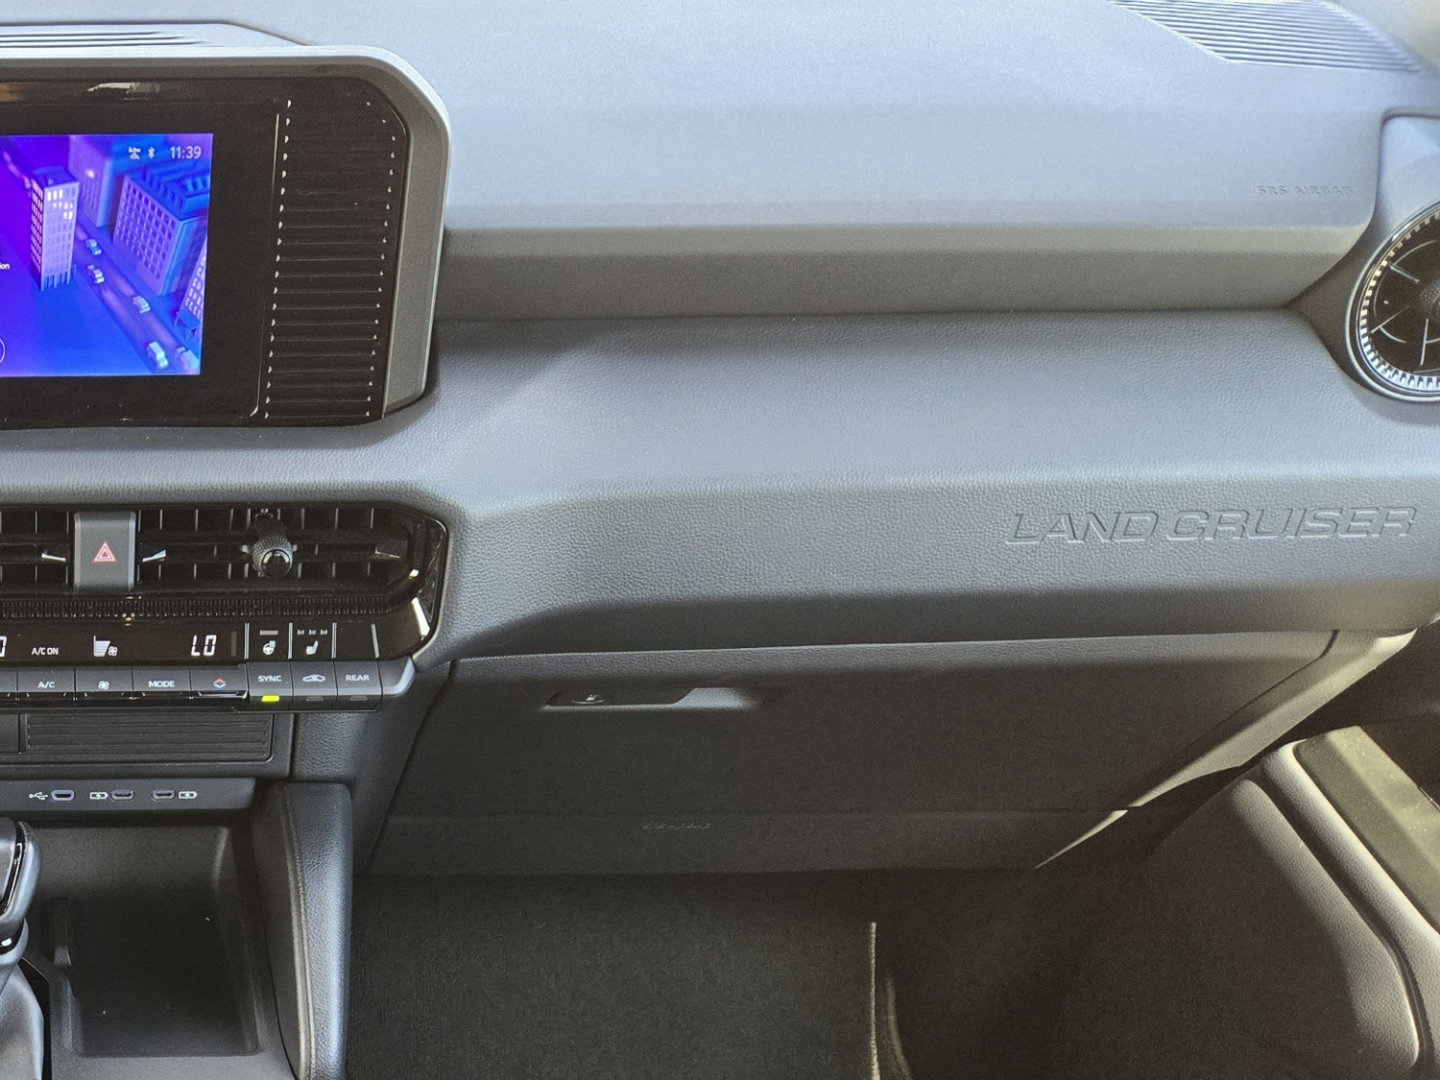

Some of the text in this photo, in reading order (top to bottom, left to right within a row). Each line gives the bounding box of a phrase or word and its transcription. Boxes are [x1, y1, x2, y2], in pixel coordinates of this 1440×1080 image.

[170, 146, 202, 160] 11:39
[1006, 505, 1418, 545] LAND CRUISER
[31, 647, 59, 656] A/C ON
[191, 635, 217, 657] LO
[37, 680, 56, 689] A/C
[148, 680, 175, 689] MODE
